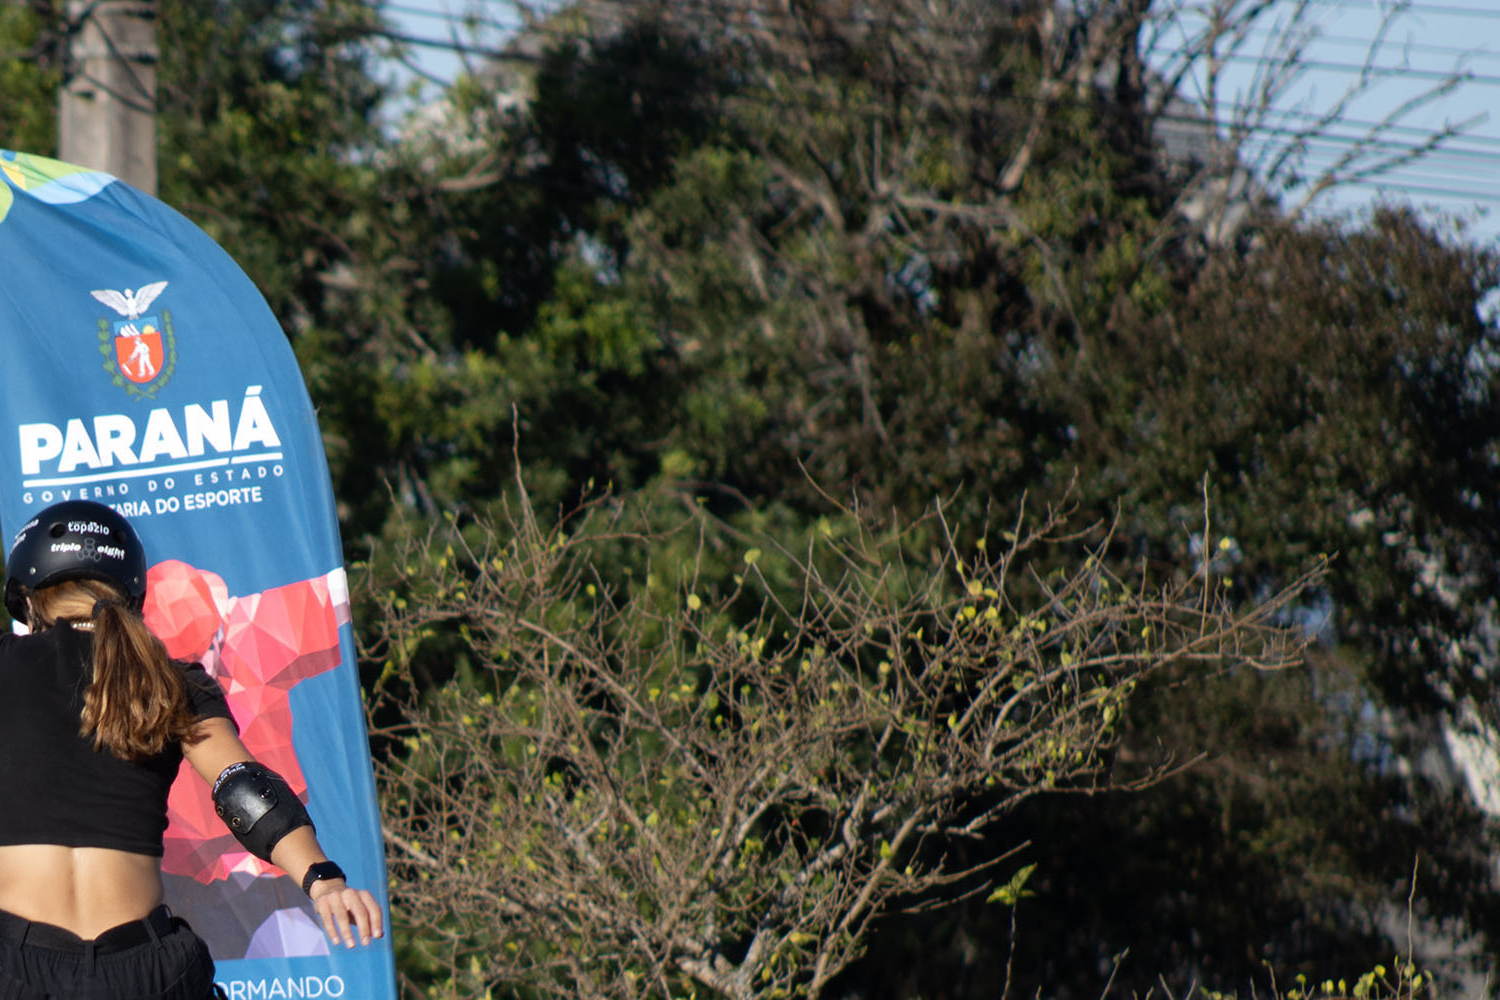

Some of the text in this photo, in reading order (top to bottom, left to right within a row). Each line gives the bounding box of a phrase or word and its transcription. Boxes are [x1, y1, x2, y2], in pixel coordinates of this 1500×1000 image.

[18, 385, 282, 475] PARANÁ
[23, 465, 283, 504] GOVERNO DO ESTADO
[155, 496, 180, 514] DO
[184, 487, 262, 510] ESPORTE
